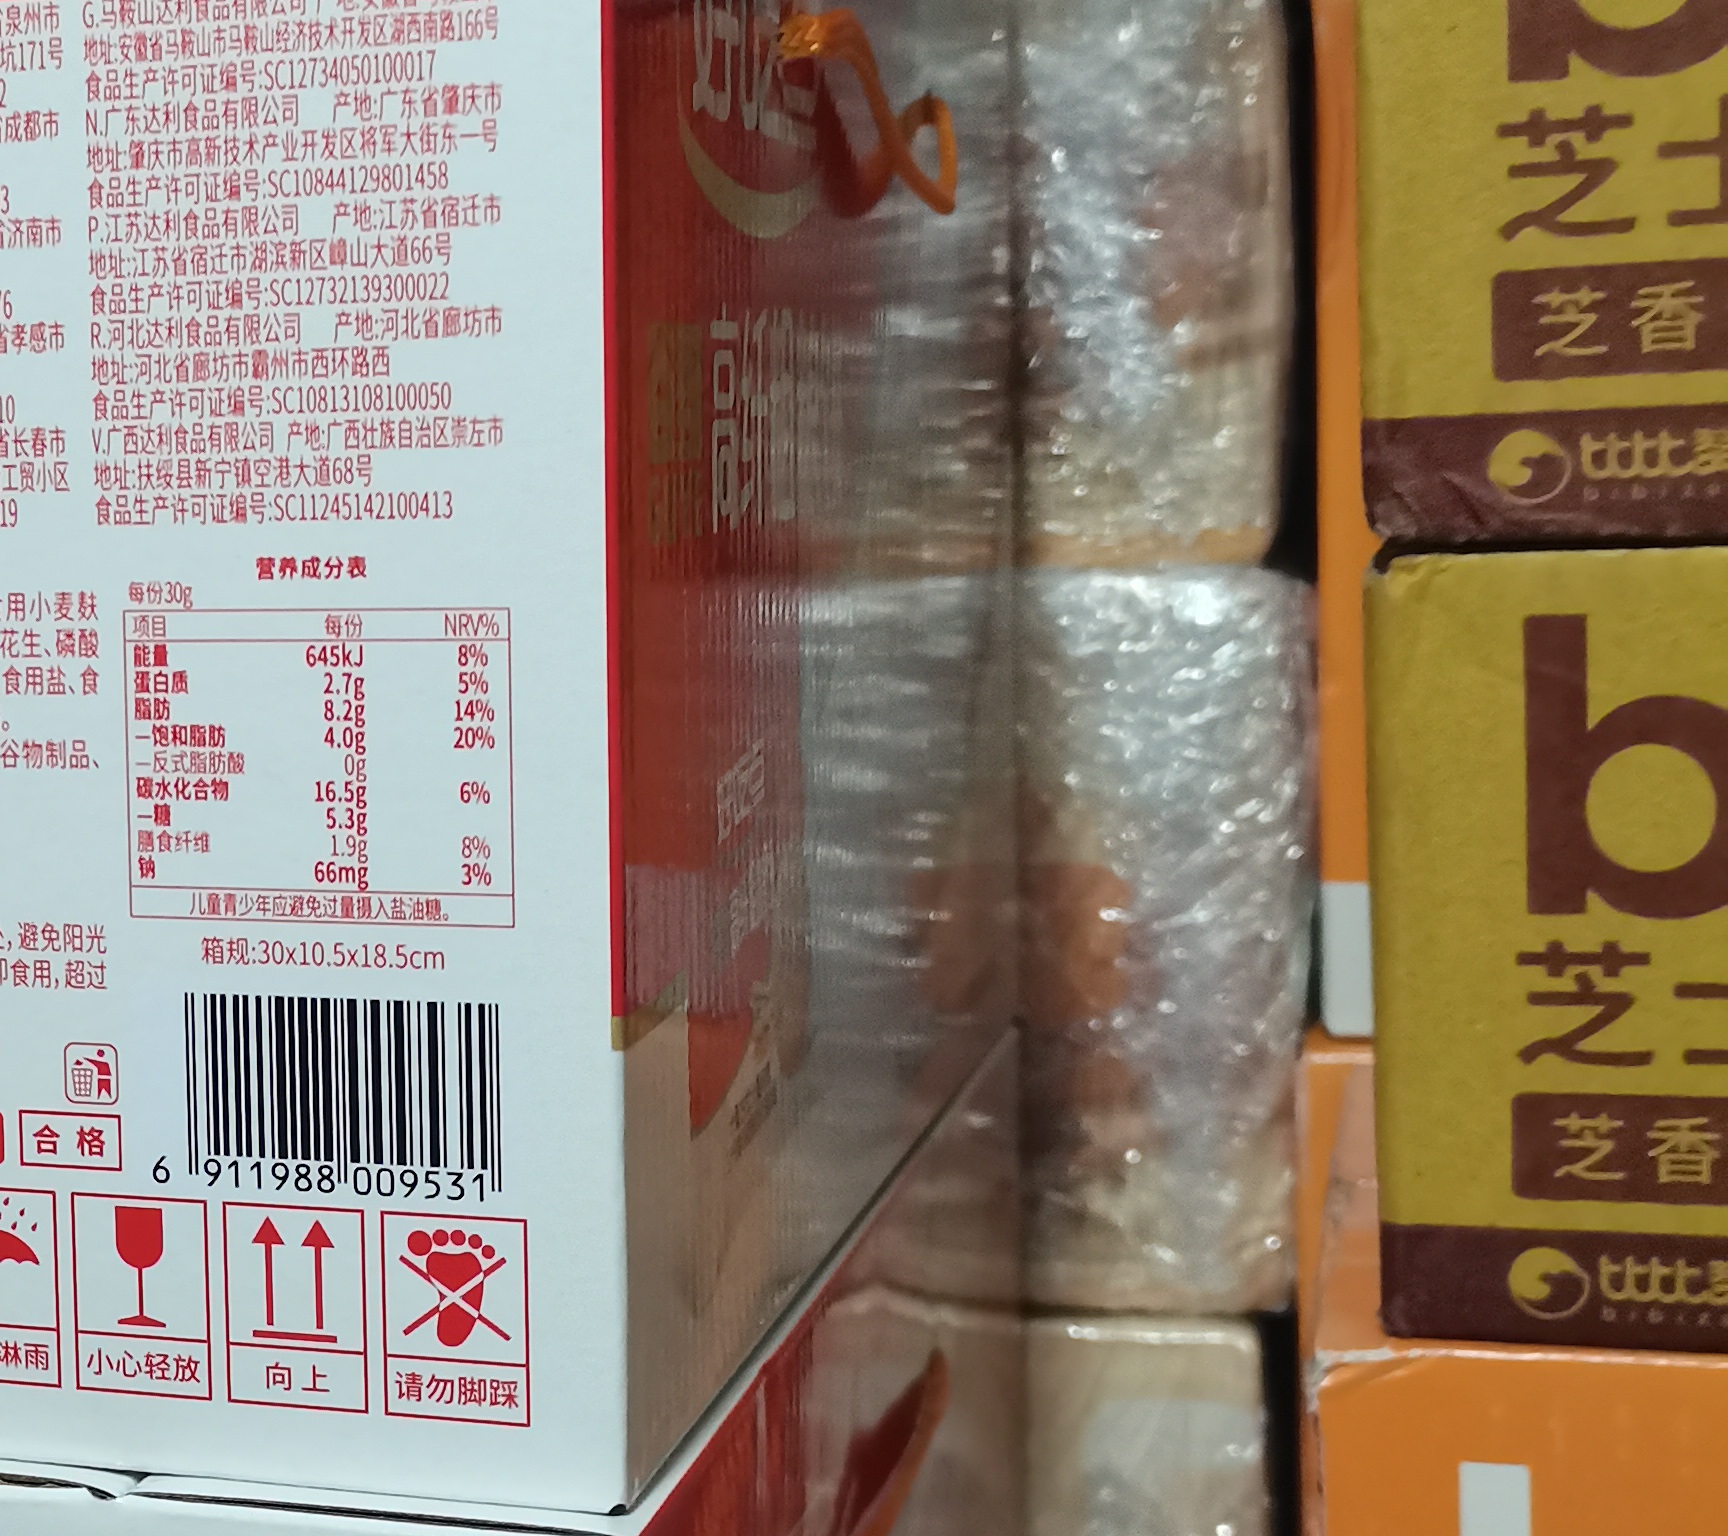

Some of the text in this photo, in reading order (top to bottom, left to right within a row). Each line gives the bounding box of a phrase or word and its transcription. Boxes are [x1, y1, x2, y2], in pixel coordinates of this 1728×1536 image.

[86, 94, 298, 137] N.广东达利食品有限公司
[88, 194, 500, 245] P.江苏达利食品有限公司 产地:江苏省宿迁市
[91, 313, 300, 351] R.河北达利食品有限公司
[92, 422, 274, 456] V.广西达利食品有限公司
[256, 556, 367, 581] 营养成分表
[127, 581, 194, 611] 每份30g
[133, 613, 499, 639] 项目 每份 NRV%
[134, 643, 488, 668] 能量 645kJ 8%
[134, 670, 488, 702] 蛋白质 2.7g 5%
[134, 697, 494, 729] 脂肪 8.2g 14%
[324, 725, 495, 756] 4.0g 20%
[344, 754, 367, 783] 0g
[136, 776, 490, 811] 碳水化合物 16.5g 6%
[326, 807, 367, 837] 5.3g
[329, 834, 368, 865] 1.9g
[462, 836, 490, 860] 8%
[138, 855, 492, 891] 钠 66mg 3%
[201, 936, 444, 970] 箱规:30x10.5x18.5cm
[153, 1155, 486, 1204] 6 911988 009531
[83, 1348, 200, 1389] 小心轻放
[392, 1371, 519, 1417] 请勿脚踩
